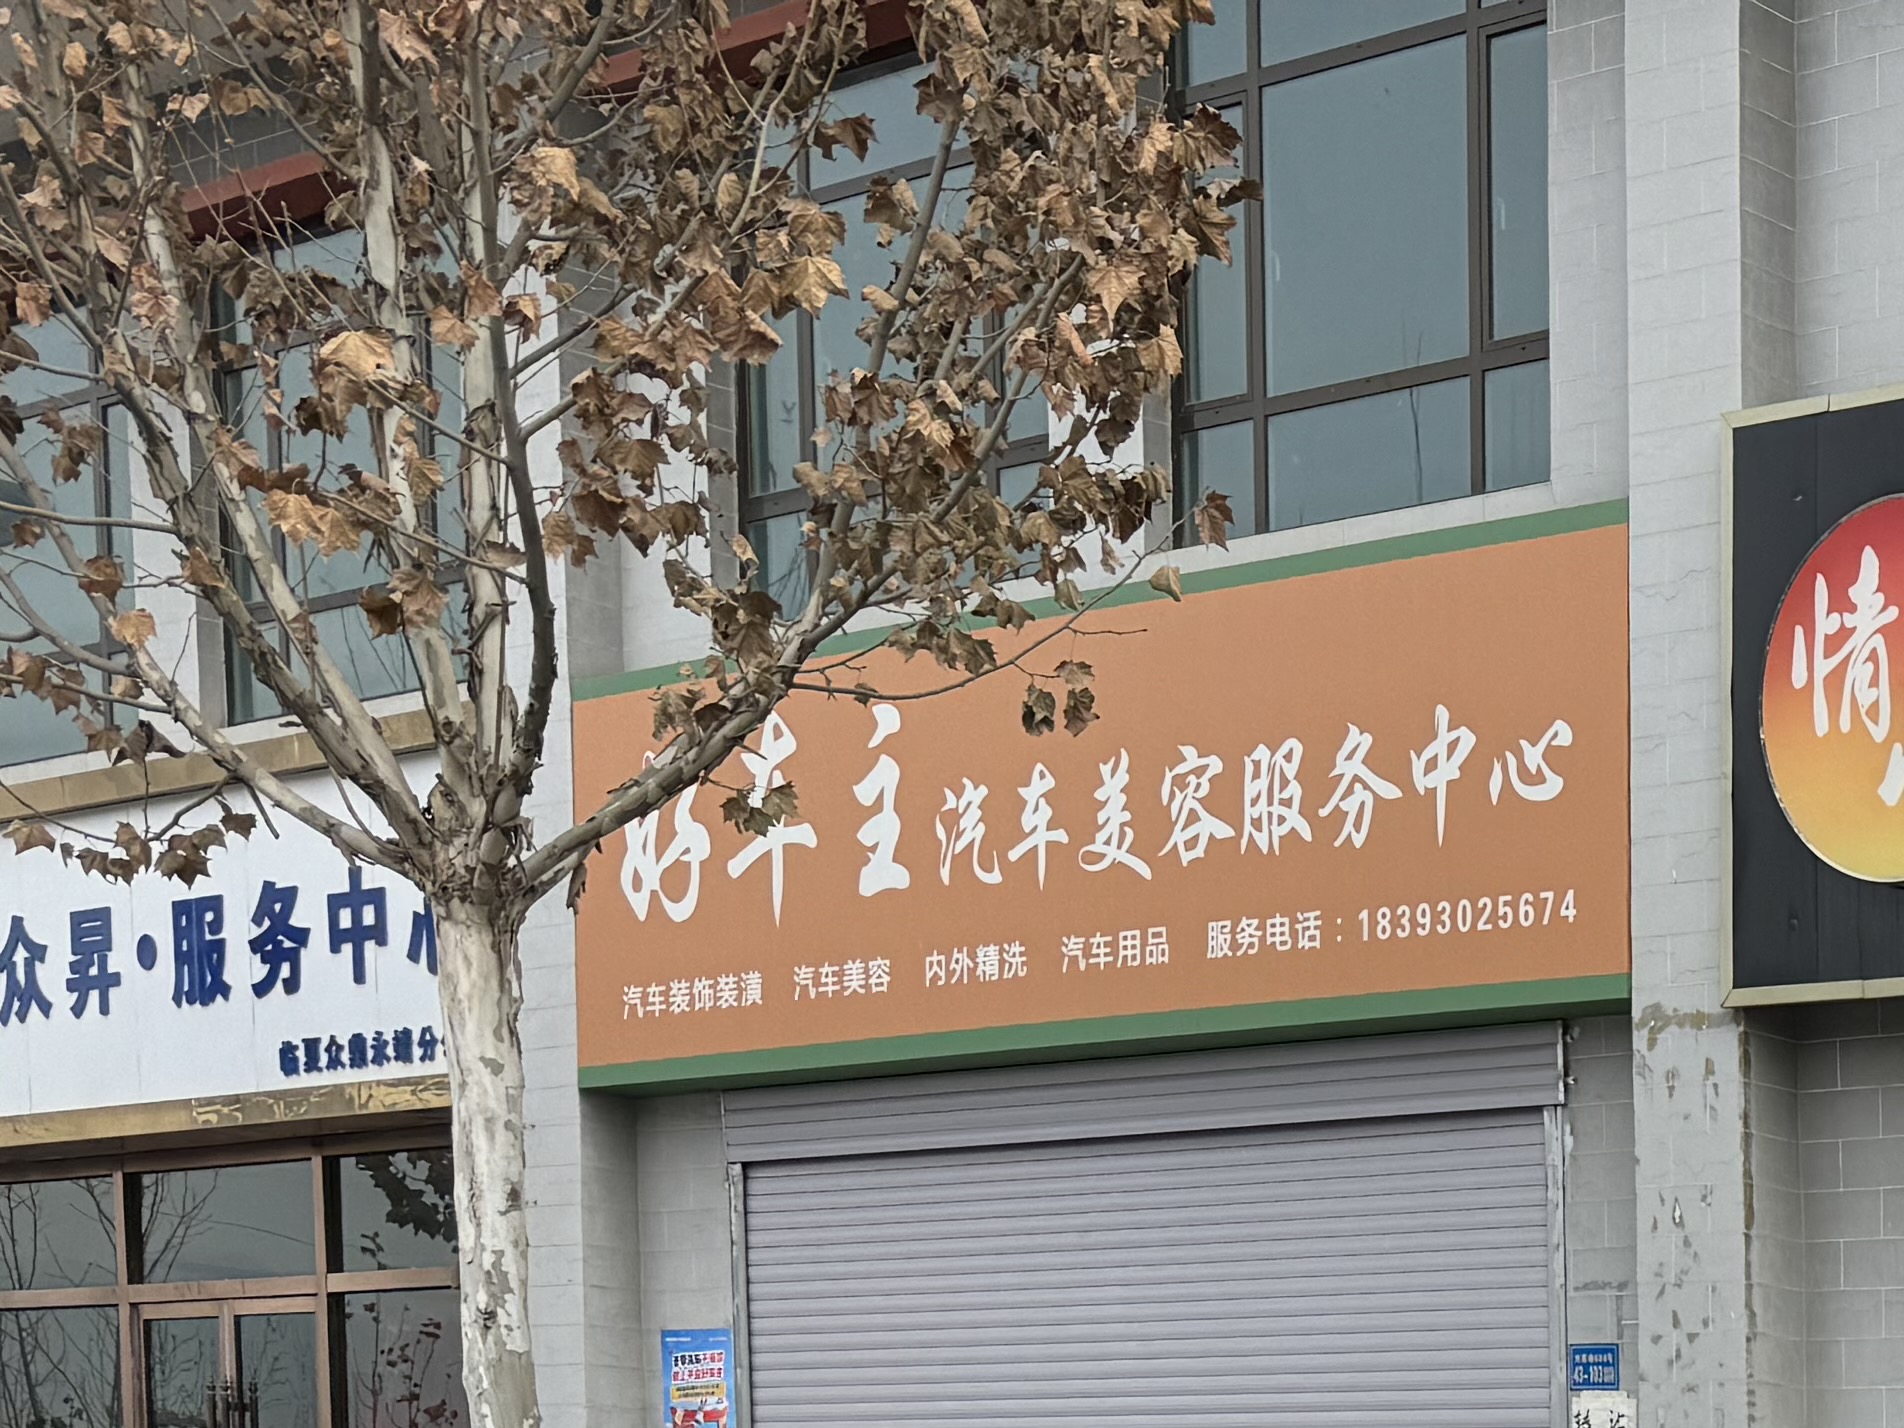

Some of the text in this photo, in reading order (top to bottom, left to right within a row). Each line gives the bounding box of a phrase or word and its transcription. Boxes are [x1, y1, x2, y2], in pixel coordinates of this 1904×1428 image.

[622, 971, 763, 1020] 汽车装饰装潢
[793, 956, 891, 1000] 汽车美容
[924, 940, 1028, 987] 内外精洗
[1061, 926, 1170, 974] 汽车用品
